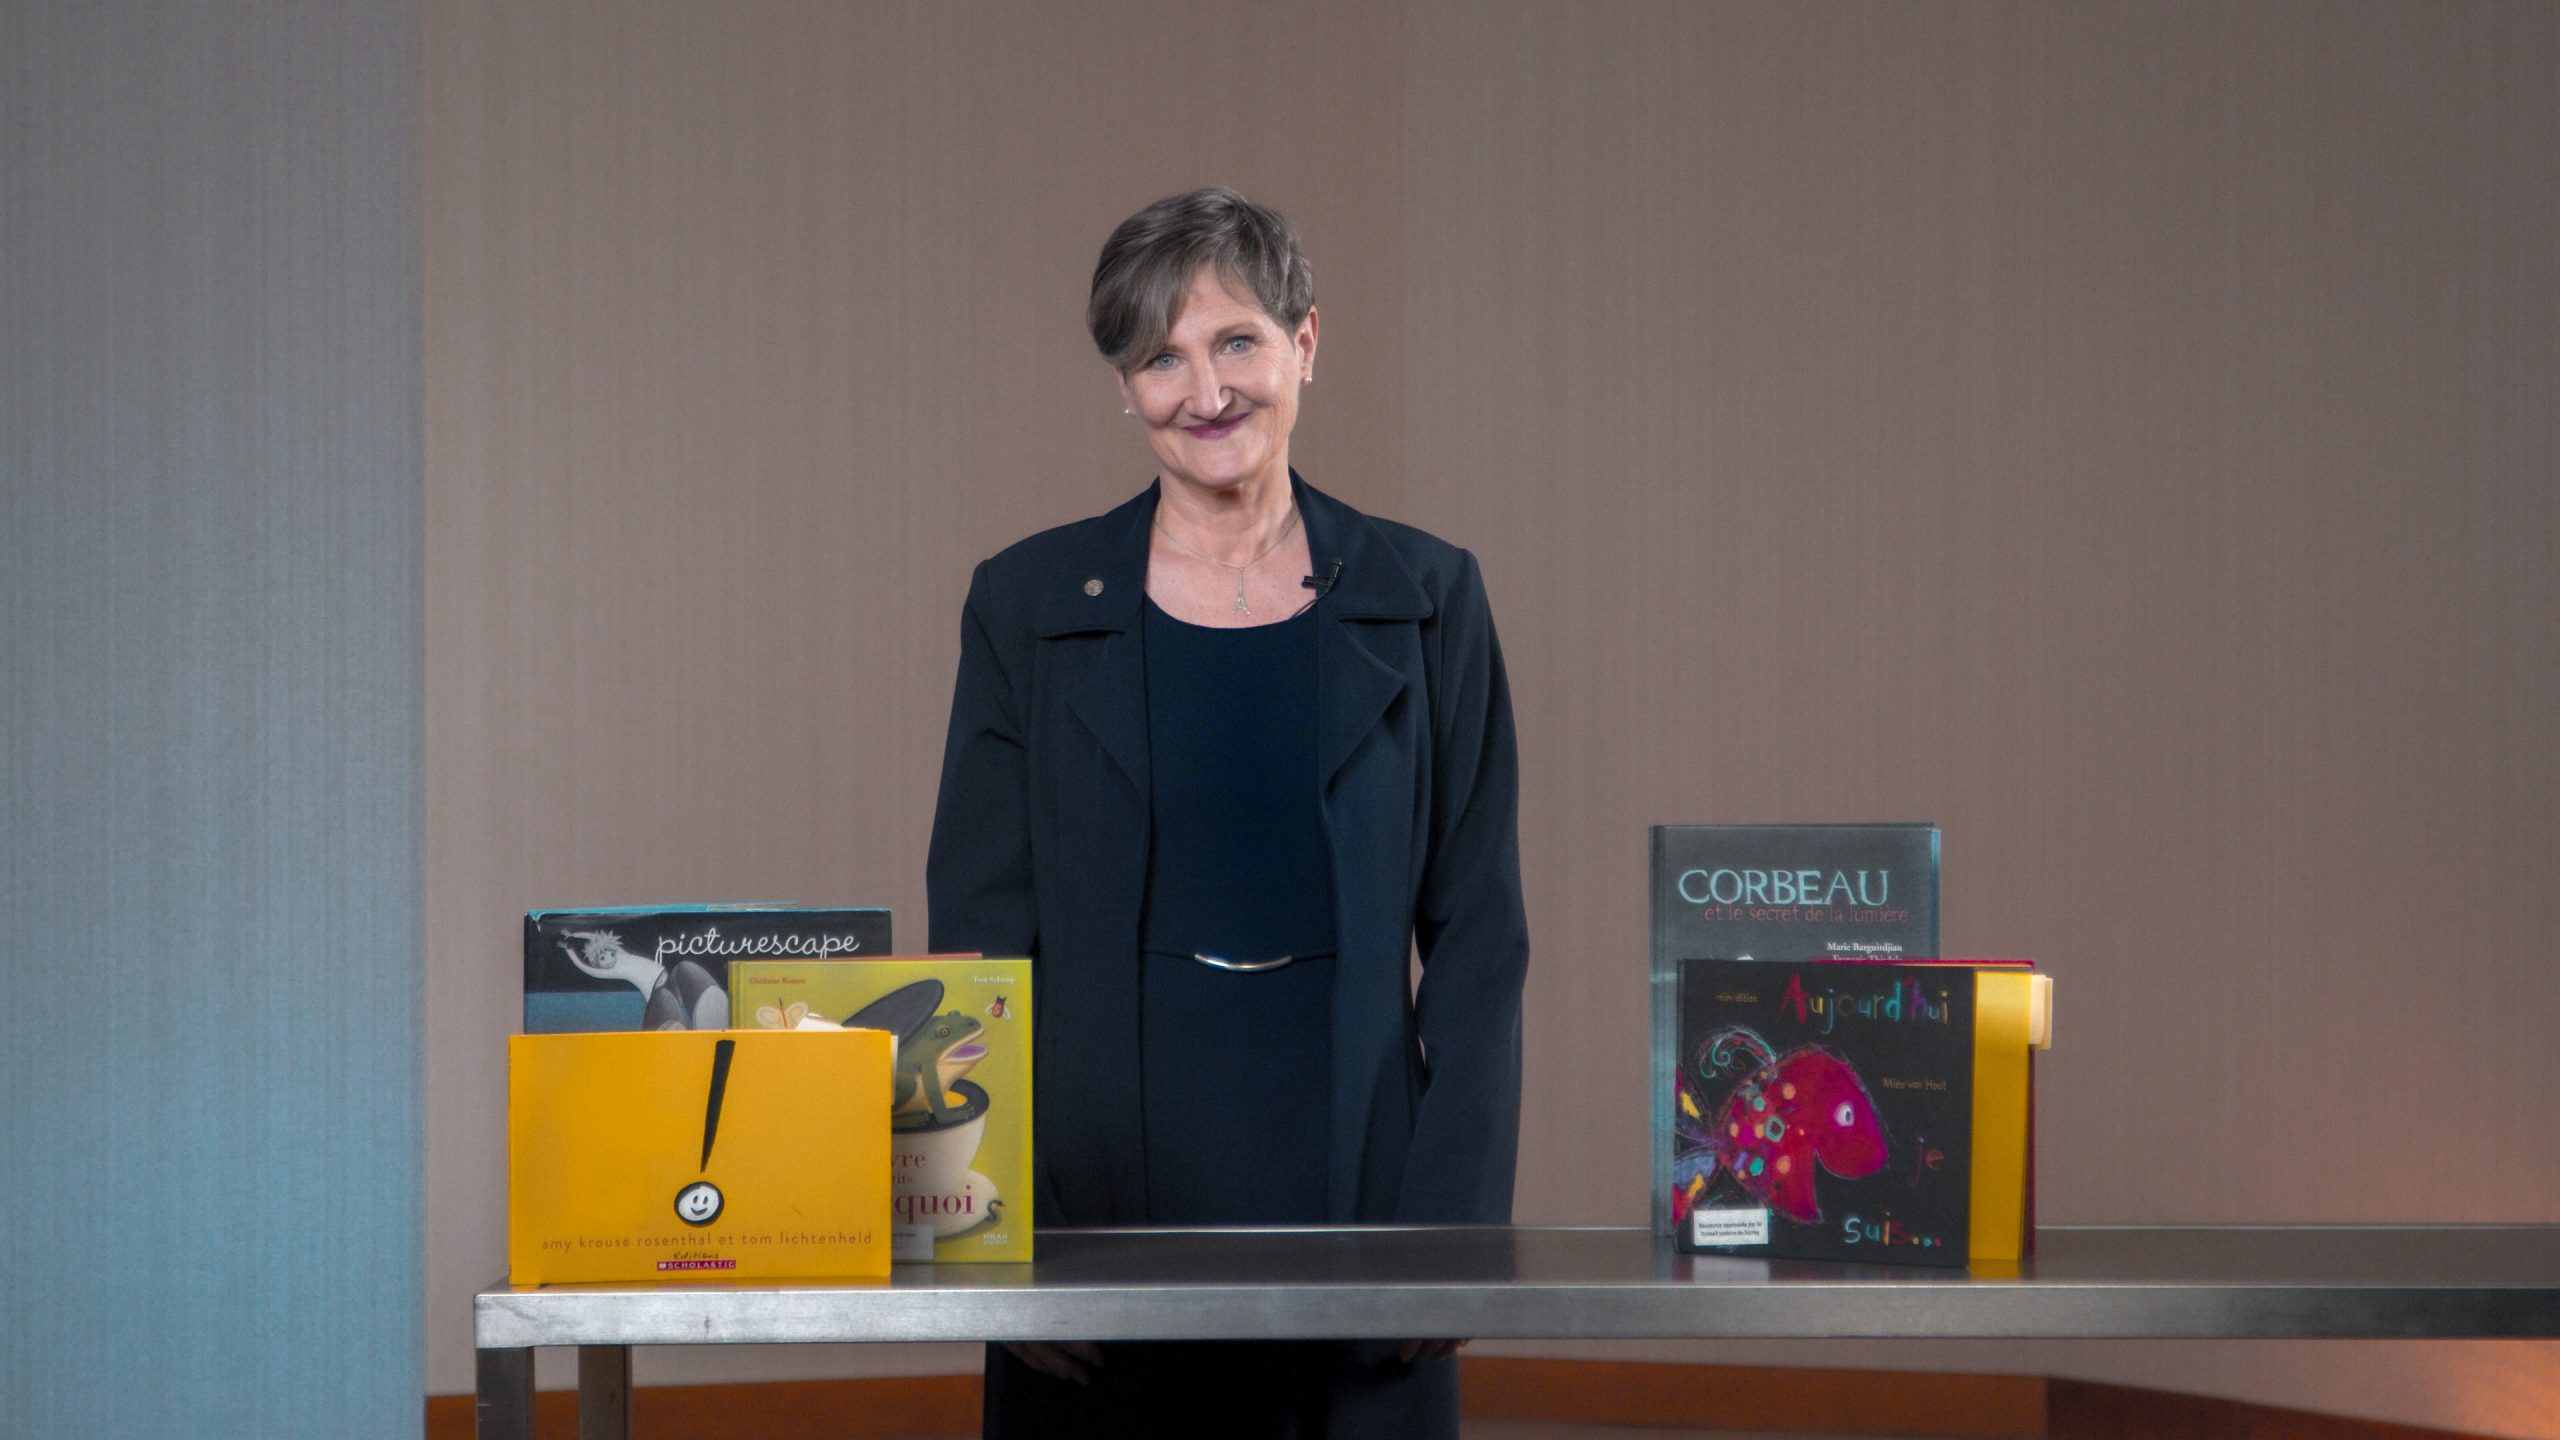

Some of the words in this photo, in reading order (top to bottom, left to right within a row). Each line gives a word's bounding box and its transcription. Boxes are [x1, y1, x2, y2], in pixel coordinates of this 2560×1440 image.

[1678, 868, 1890, 906] CORBEAU
[1703, 903, 1722, 921] et
[1728, 902, 1743, 921] le
[1750, 904, 1800, 922] secret
[1804, 903, 1824, 922] de
[1829, 902, 1844, 922] la
[1850, 902, 1910, 923] lumière
[655, 927, 860, 966] picturescape
[1826, 942, 1851, 951] Marie
[541, 1239, 573, 1254] amy
[579, 1236, 631, 1249] krouse
[637, 1233, 712, 1248] rosenthal
[718, 1234, 734, 1246] et
[742, 1233, 773, 1246] tom
[780, 1231, 873, 1246] lichtenheld
[667, 1261, 736, 1270] SCHOLASTIC
